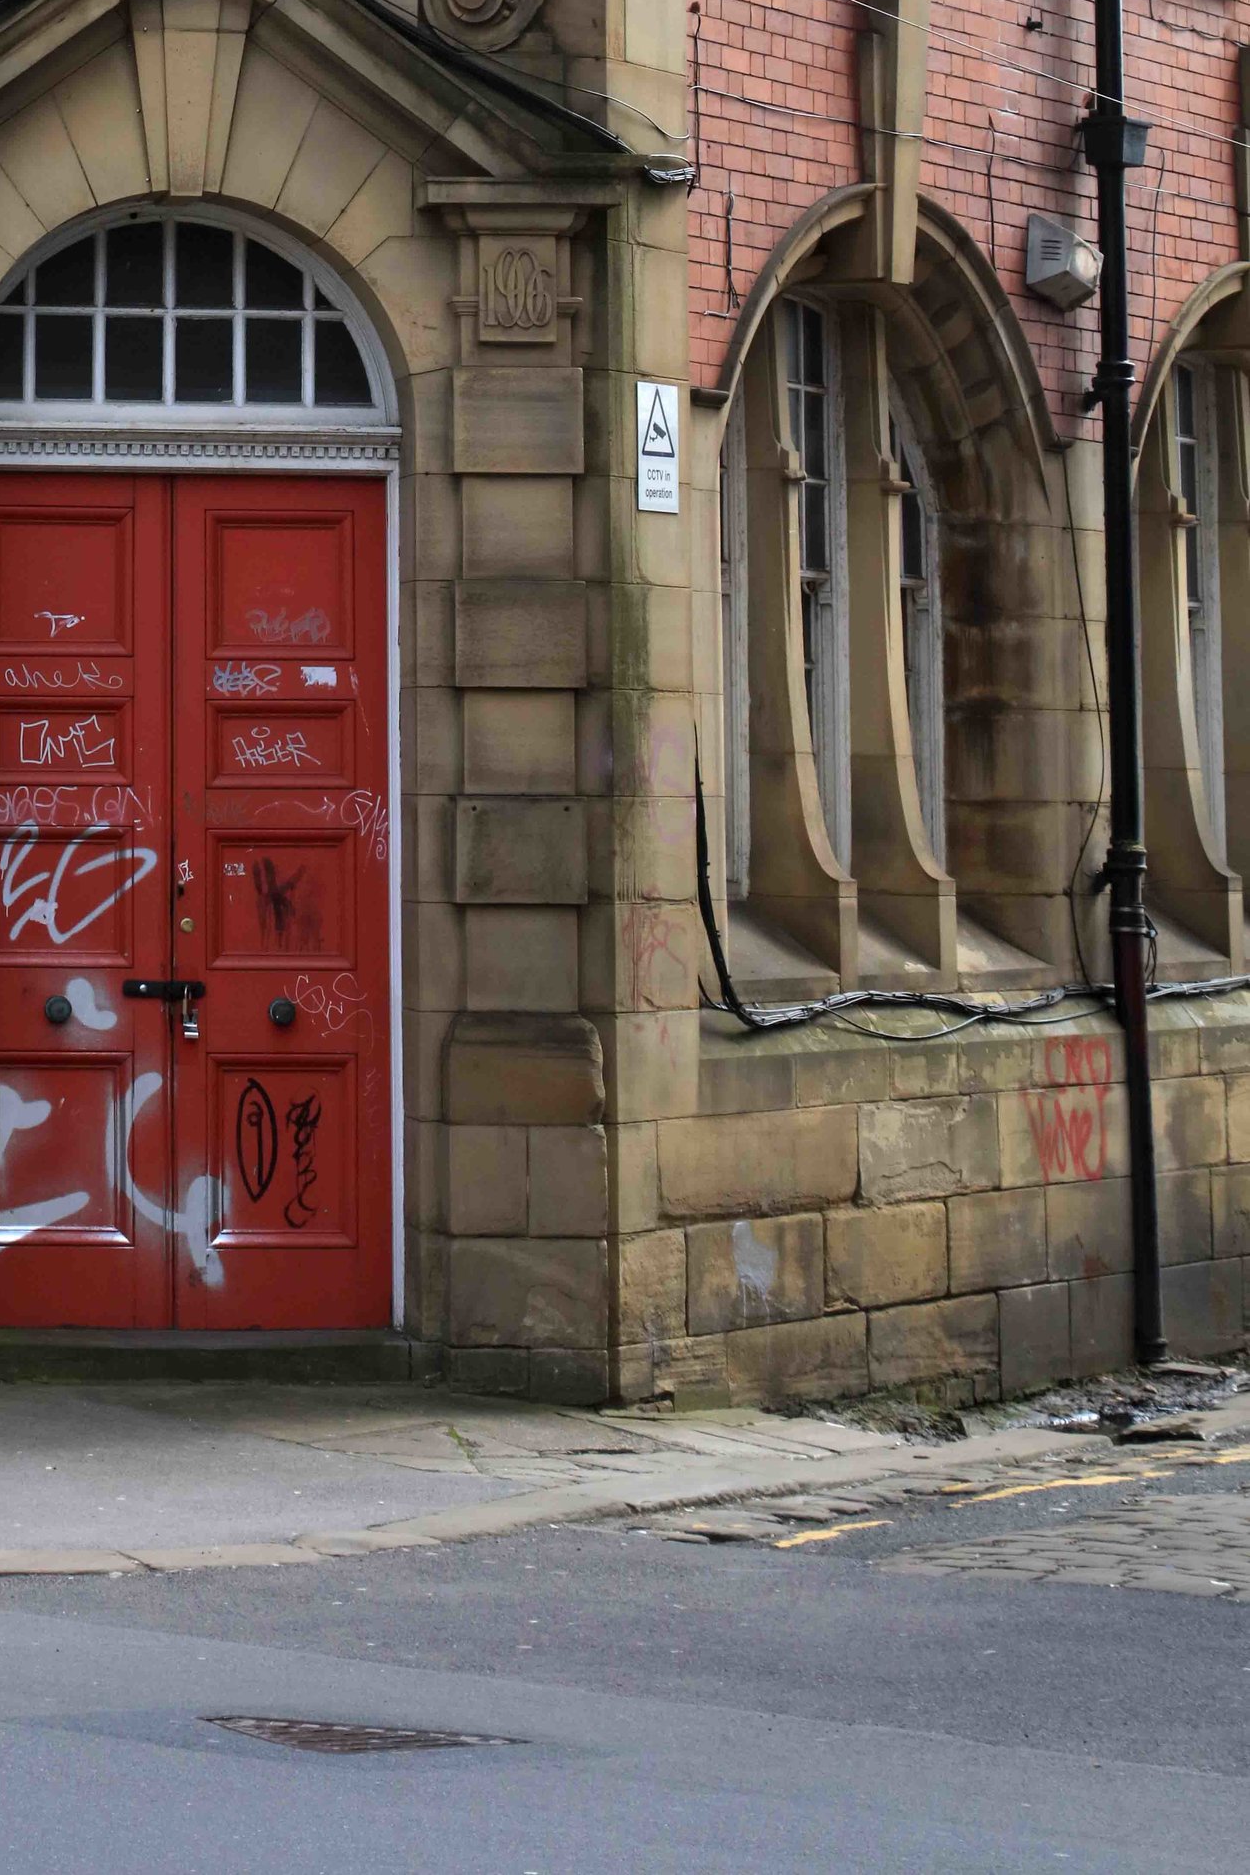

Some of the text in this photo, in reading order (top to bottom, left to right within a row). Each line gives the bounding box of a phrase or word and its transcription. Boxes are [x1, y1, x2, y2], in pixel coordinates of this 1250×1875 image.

[647, 469, 671, 481] CCTV in
[645, 488, 672, 500] operation
